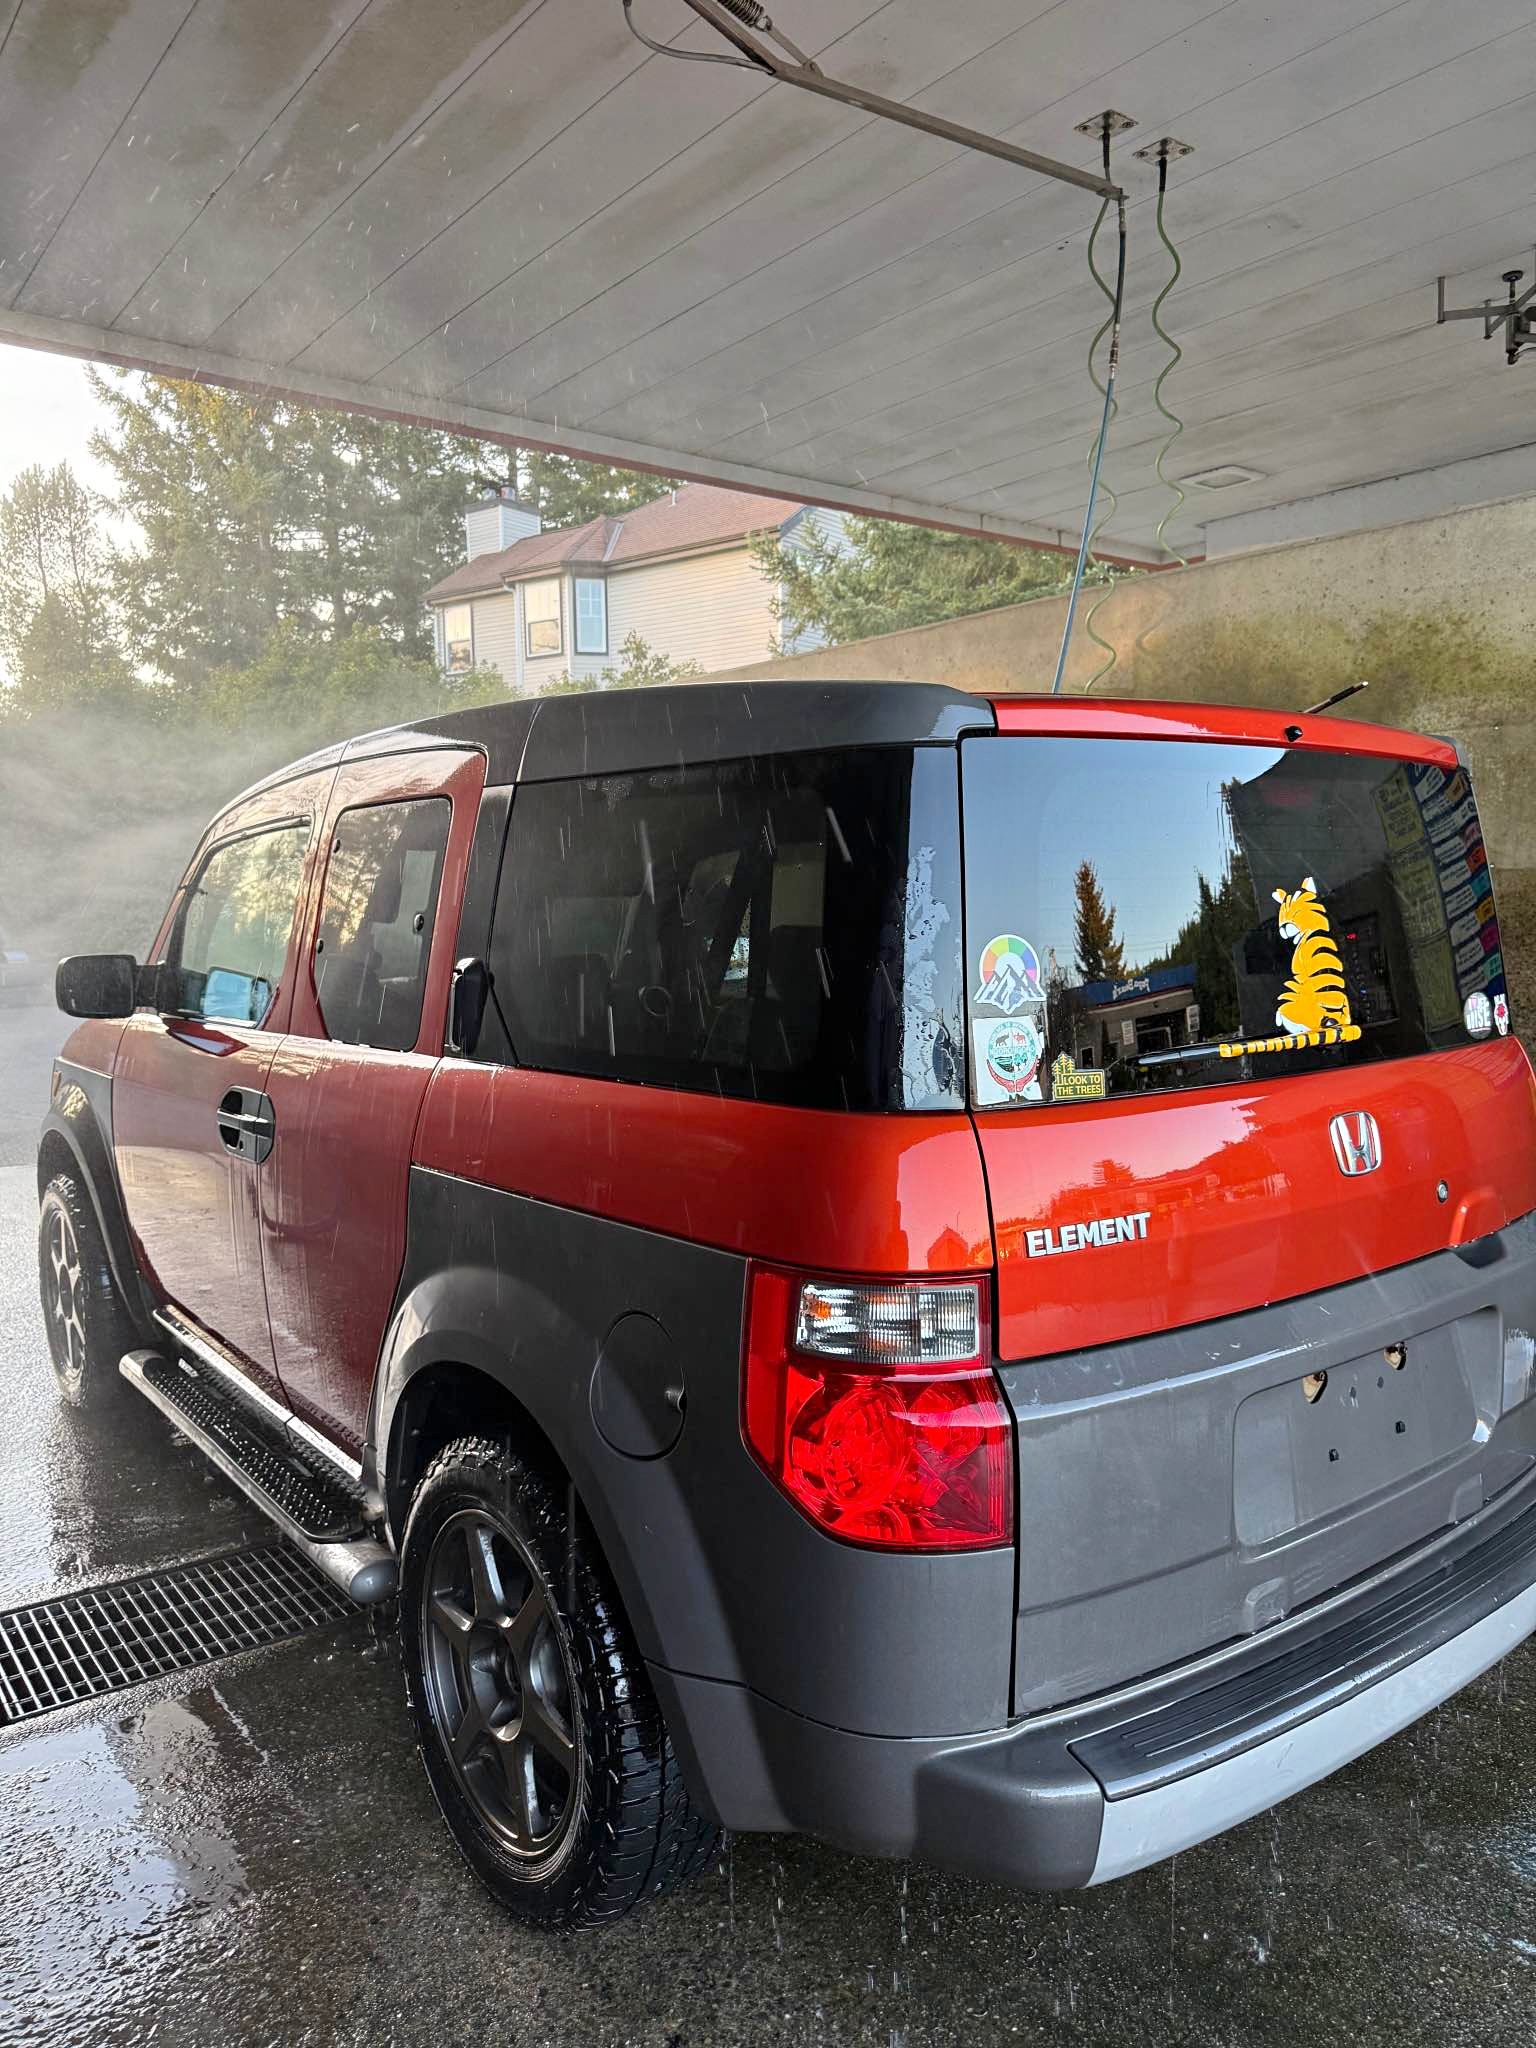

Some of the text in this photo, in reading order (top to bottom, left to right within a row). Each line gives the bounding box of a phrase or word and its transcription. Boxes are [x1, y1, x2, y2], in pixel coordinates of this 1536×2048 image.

[1063, 1075, 1101, 1085] LOOK TO
[1057, 1085, 1101, 1096] THE TREES
[1025, 1211, 1151, 1257] ELEMENT
